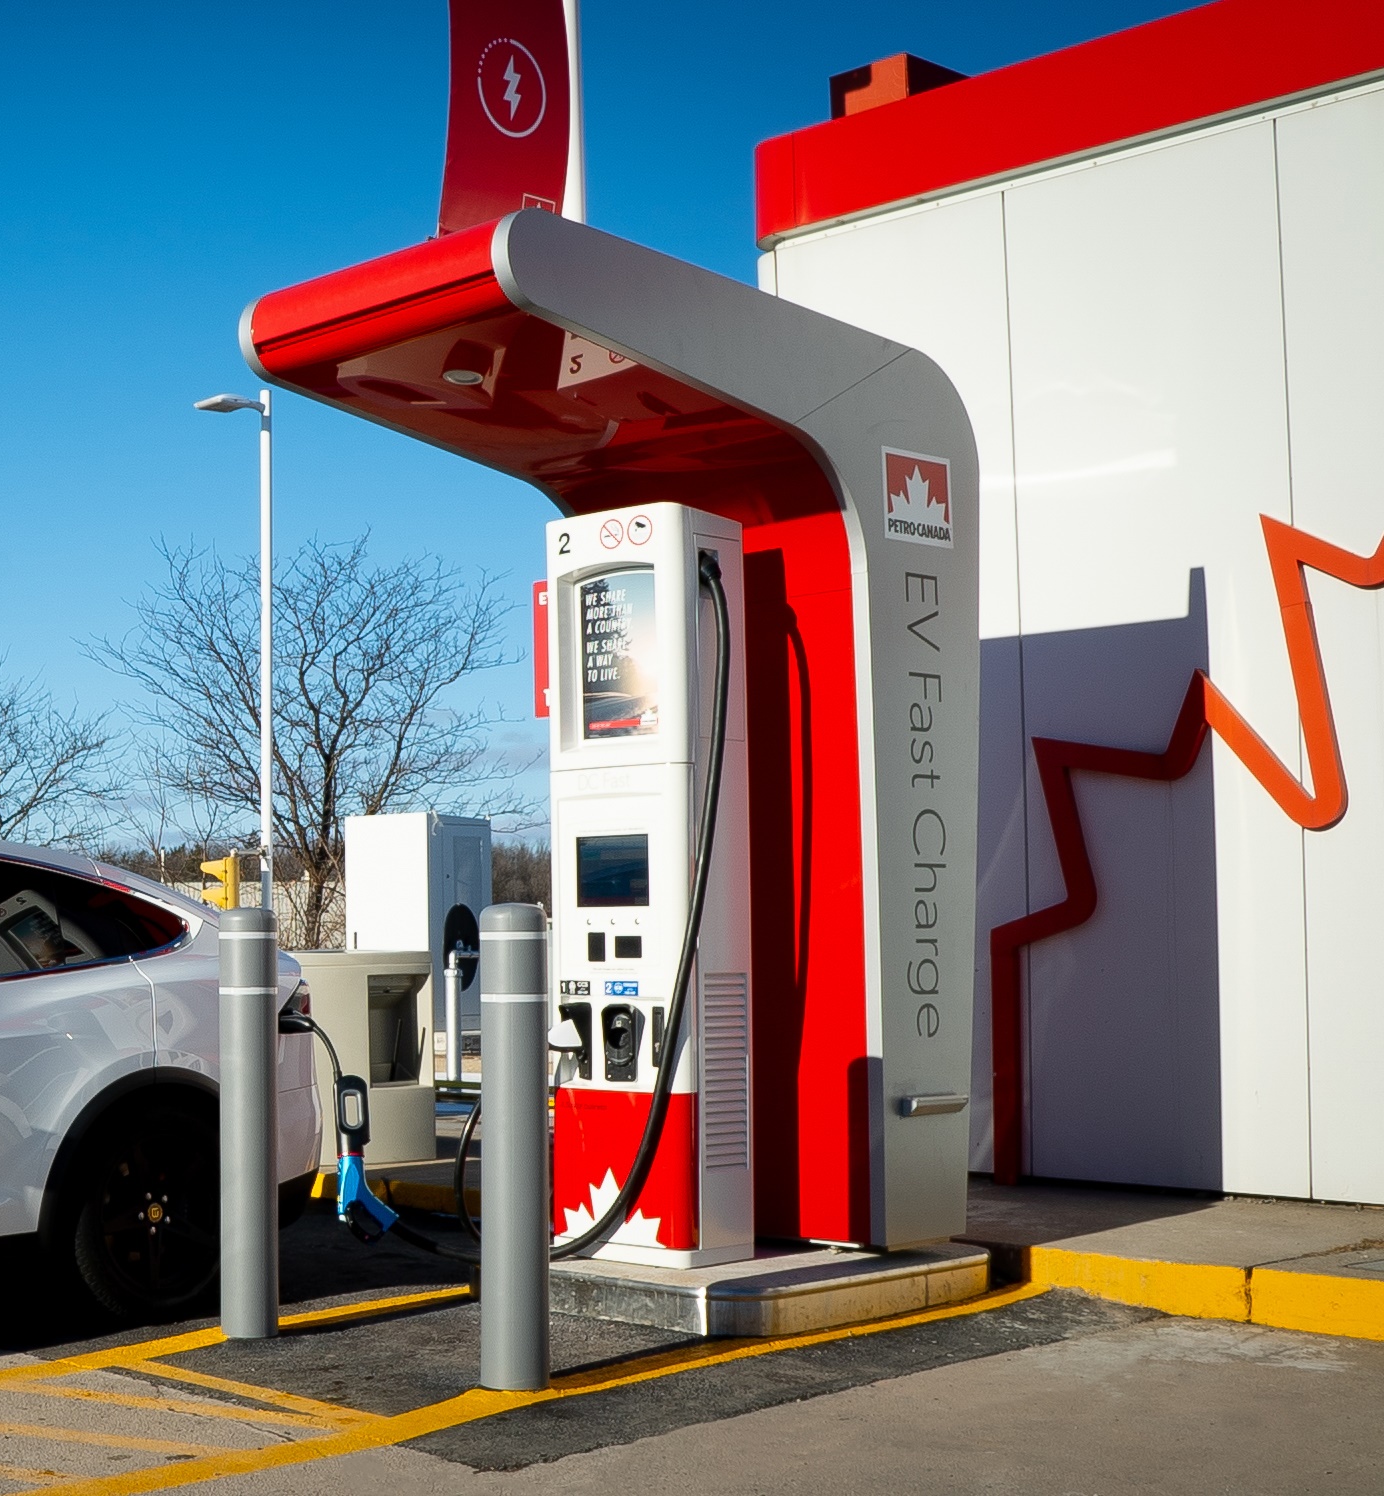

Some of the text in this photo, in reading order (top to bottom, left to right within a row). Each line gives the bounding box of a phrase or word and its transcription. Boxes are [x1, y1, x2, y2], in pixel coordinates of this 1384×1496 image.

[558, 532, 571, 555] 2
[585, 589, 626, 606] WE SHARE
[586, 603, 633, 620] MORE THAN
[586, 622, 593, 635] A
[586, 637, 627, 654] WE SHARE
[587, 654, 614, 668] A WAY
[587, 667, 621, 683] TO LIVE.
[602, 771, 630, 788] Fast
[905, 571, 947, 1038] EV Fast Charge
[561, 982, 566, 993] 1
[605, 983, 612, 994] 2
